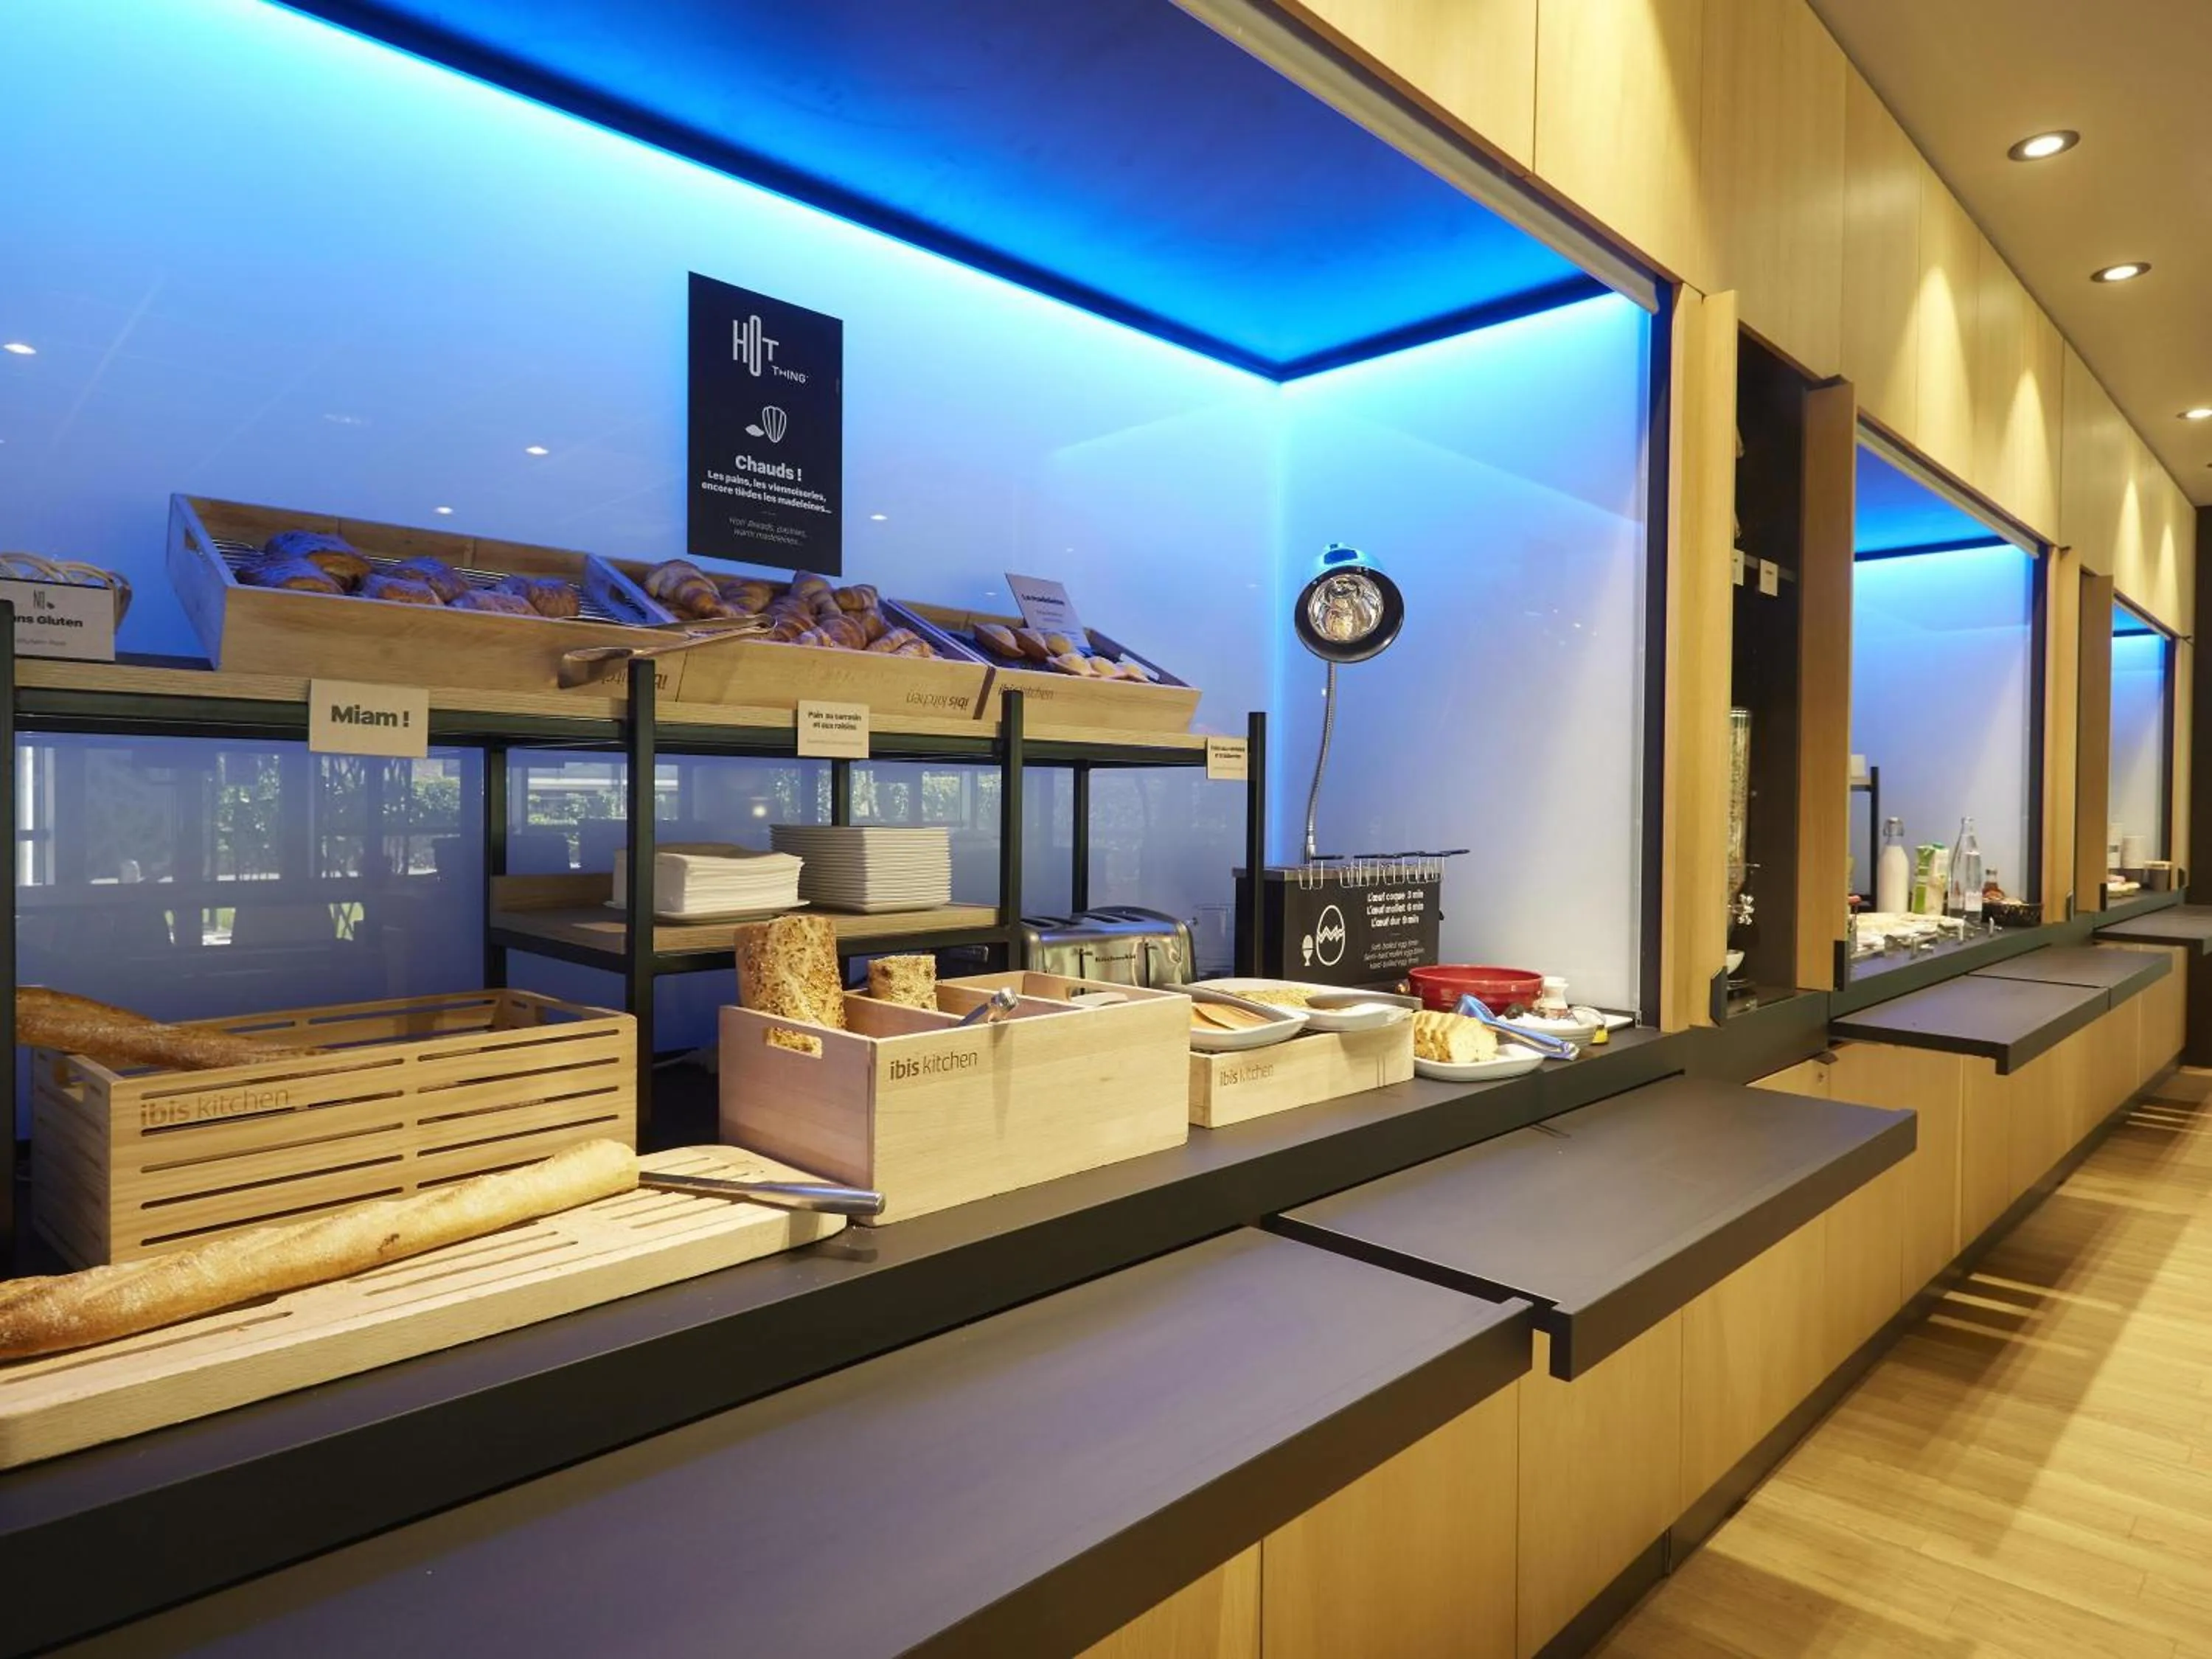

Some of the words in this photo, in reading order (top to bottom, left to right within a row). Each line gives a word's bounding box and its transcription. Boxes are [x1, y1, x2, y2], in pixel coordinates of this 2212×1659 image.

[732, 315, 779, 377] HOT
[771, 365, 807, 384] THING
[735, 455, 794, 480] Chauds
[797, 468, 802, 481] !
[708, 470, 724, 481] Les
[725, 474, 752, 487] pains,
[753, 478, 766, 490] les
[701, 481, 734, 495] encore
[734, 487, 762, 501] tièdes
[763, 492, 776, 503] les
[37, 615, 83, 627] Gluten
[331, 704, 398, 728] Miam
[403, 710, 410, 728] !
[889, 1058, 919, 1081] ibis
[922, 1051, 978, 1074] kitchen
[1220, 1070, 1239, 1087] ibis
[140, 1100, 190, 1126] ibis
[197, 1088, 290, 1119] kitchen
